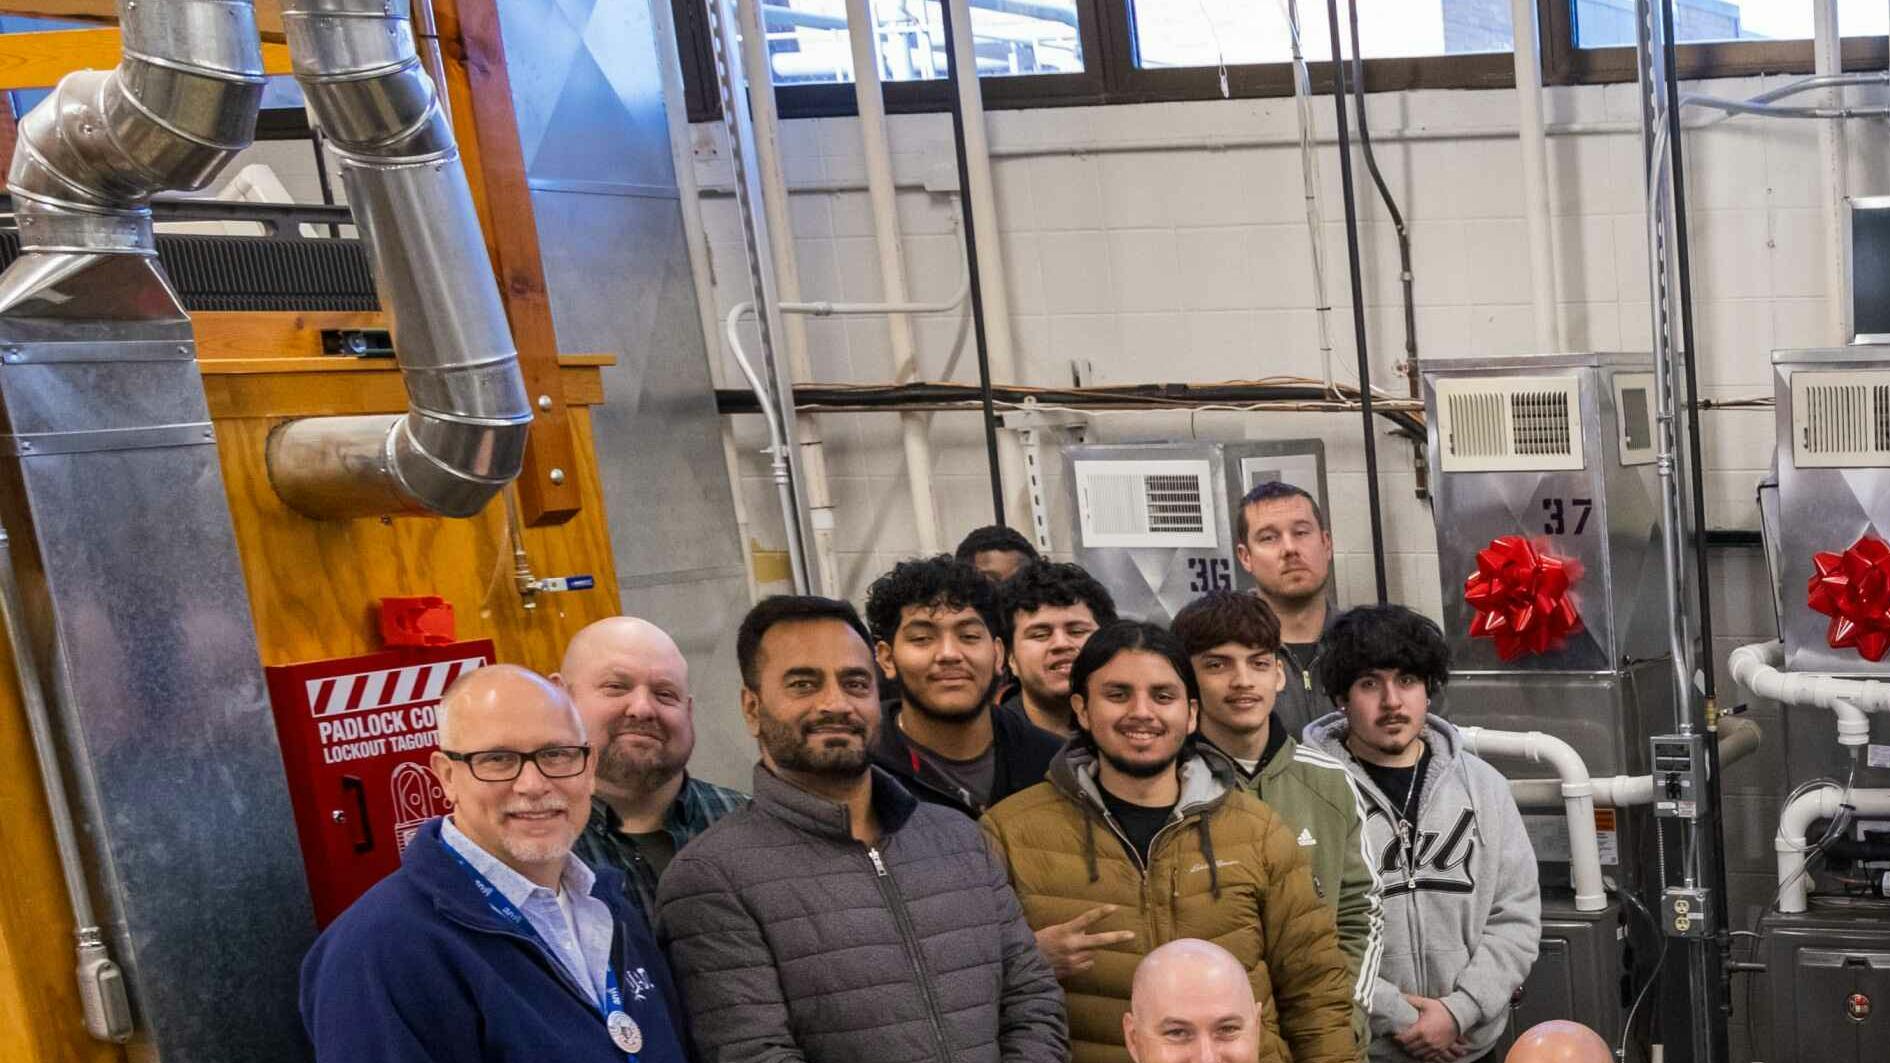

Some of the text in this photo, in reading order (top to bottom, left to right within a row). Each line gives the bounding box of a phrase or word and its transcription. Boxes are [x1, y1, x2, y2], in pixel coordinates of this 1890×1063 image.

[1542, 498, 1592, 535] 37
[318, 711, 408, 744] PADLOCK
[323, 729, 441, 764] LOCKOUT TAGOUT
